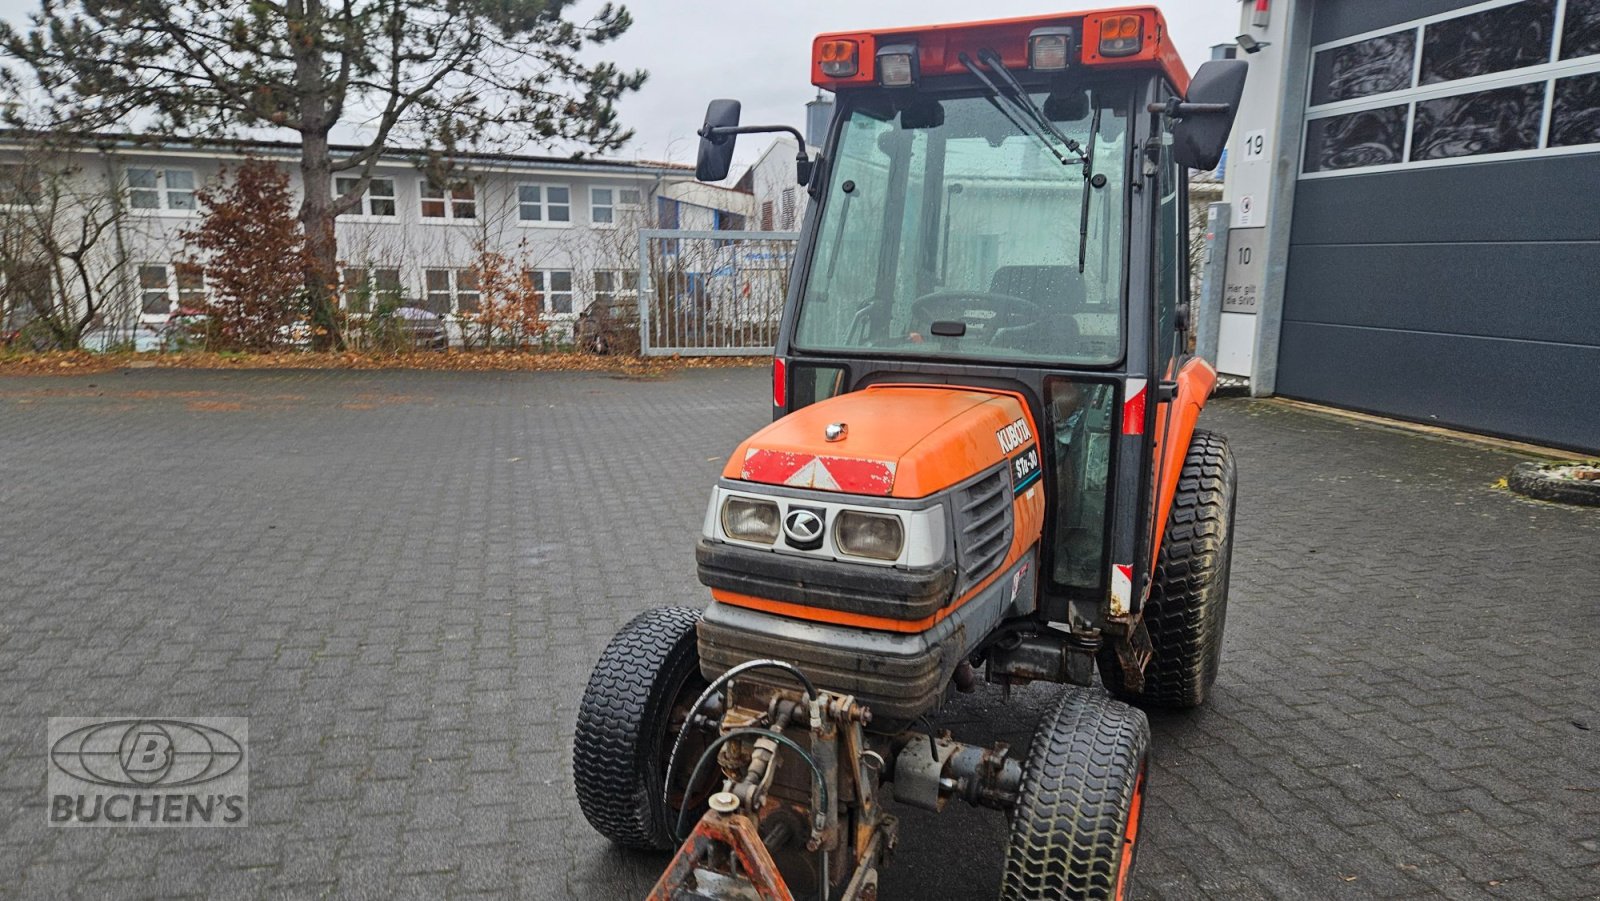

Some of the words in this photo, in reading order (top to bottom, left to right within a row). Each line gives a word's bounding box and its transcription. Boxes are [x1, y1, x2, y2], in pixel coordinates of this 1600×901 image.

[1246, 135, 1264, 156] 19
[1238, 247, 1252, 265] 10
[996, 417, 1032, 455] KUBOTA
